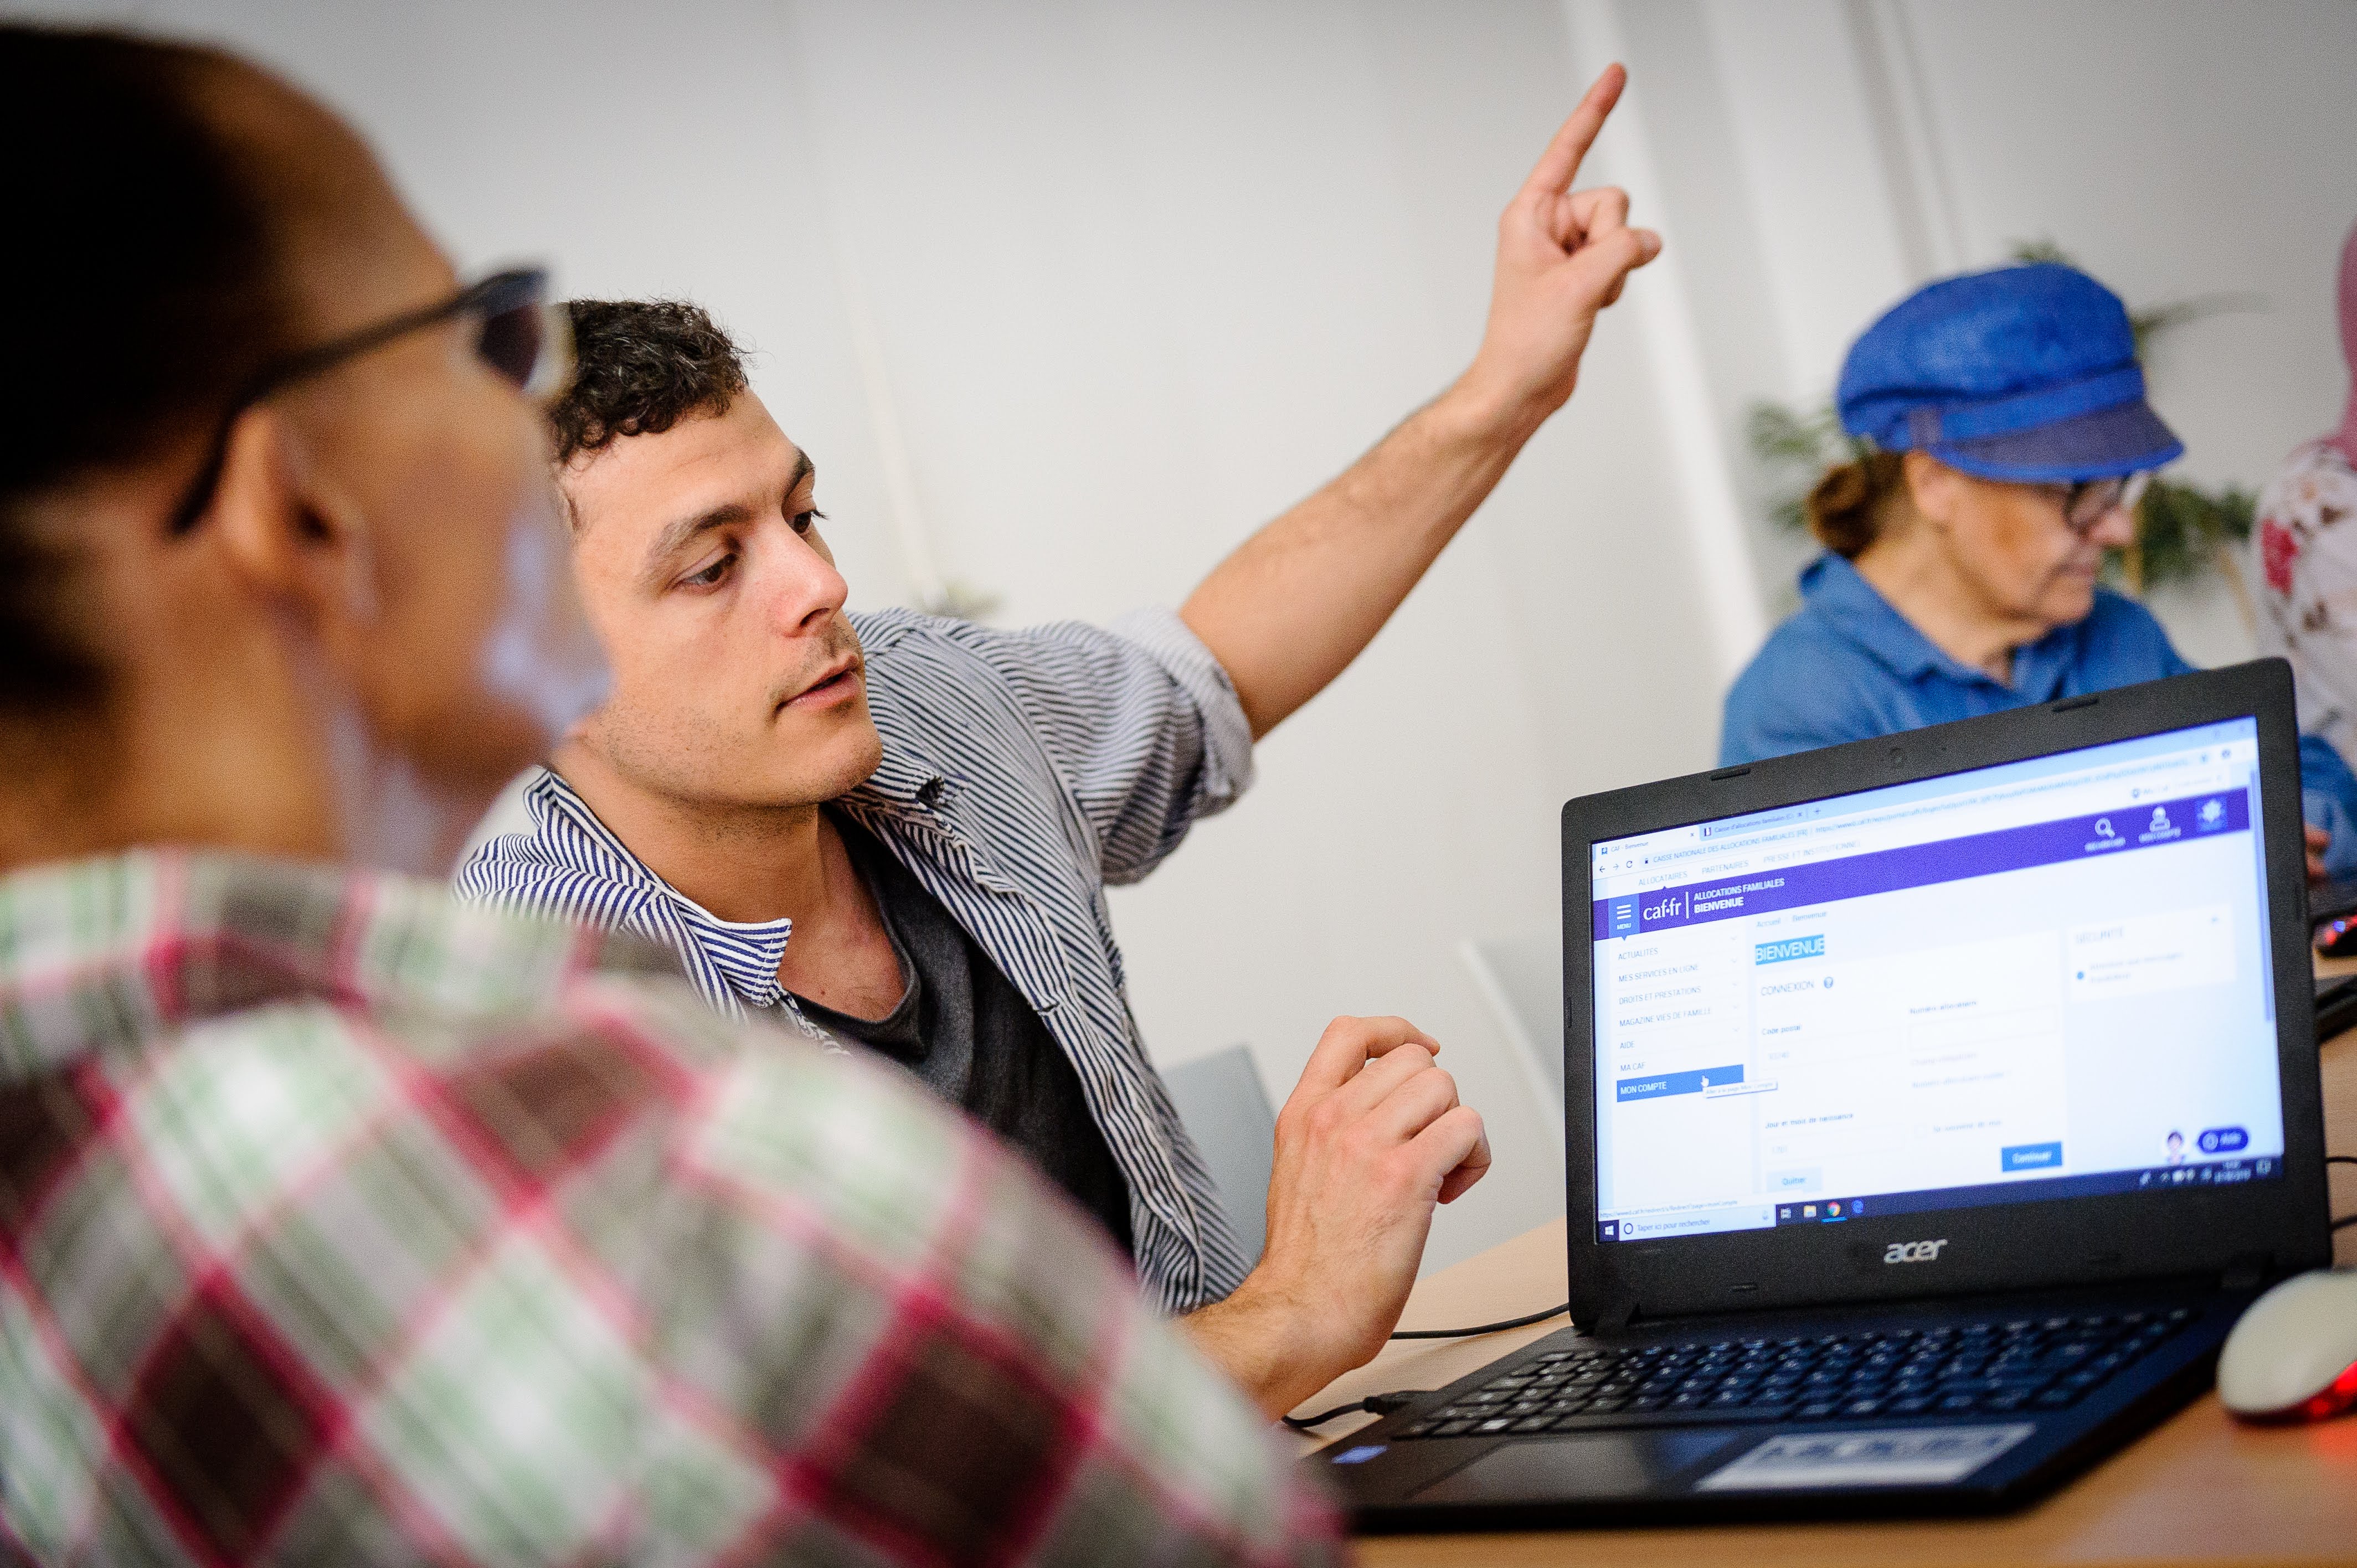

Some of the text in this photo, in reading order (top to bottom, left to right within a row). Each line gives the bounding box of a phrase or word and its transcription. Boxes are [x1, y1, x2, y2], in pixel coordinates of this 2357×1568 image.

[1653, 853, 1672, 863] CAISSE
[1674, 847, 1706, 859] NATIONALE
[1707, 844, 1720, 853] DES
[1720, 837, 1761, 850] ALLOCATIONS
[1762, 831, 1795, 843] FAMILIALES
[1702, 859, 1749, 875] PARTENAIRES
[1639, 871, 1688, 886] ALLOCATAIRES
[1694, 878, 1785, 901] ALLOCATIONS FAMILIALES
[1694, 896, 1744, 914] BIENVENUE
[1756, 937, 1825, 961] BIENVENUE
[1619, 963, 1699, 983] MES SERVICES EN LIGNE
[1619, 986, 1702, 1005] DROITS ET PRESTATIONS
[1761, 980, 1815, 997] CONNEXION
[1619, 1015, 1655, 1027] MAGAZINE
[1656, 1013, 1671, 1022] VIES
[1683, 1007, 1711, 1018] FAMILLE
[1619, 1040, 1635, 1049] AIDE
[1632, 1061, 1646, 1070] CAF
[1620, 1081, 1667, 1095] MON COMPTE
[1663, 1222, 1677, 1230] pour
[1679, 1218, 1711, 1228] rechercher
[1883, 1239, 1948, 1263] acer
